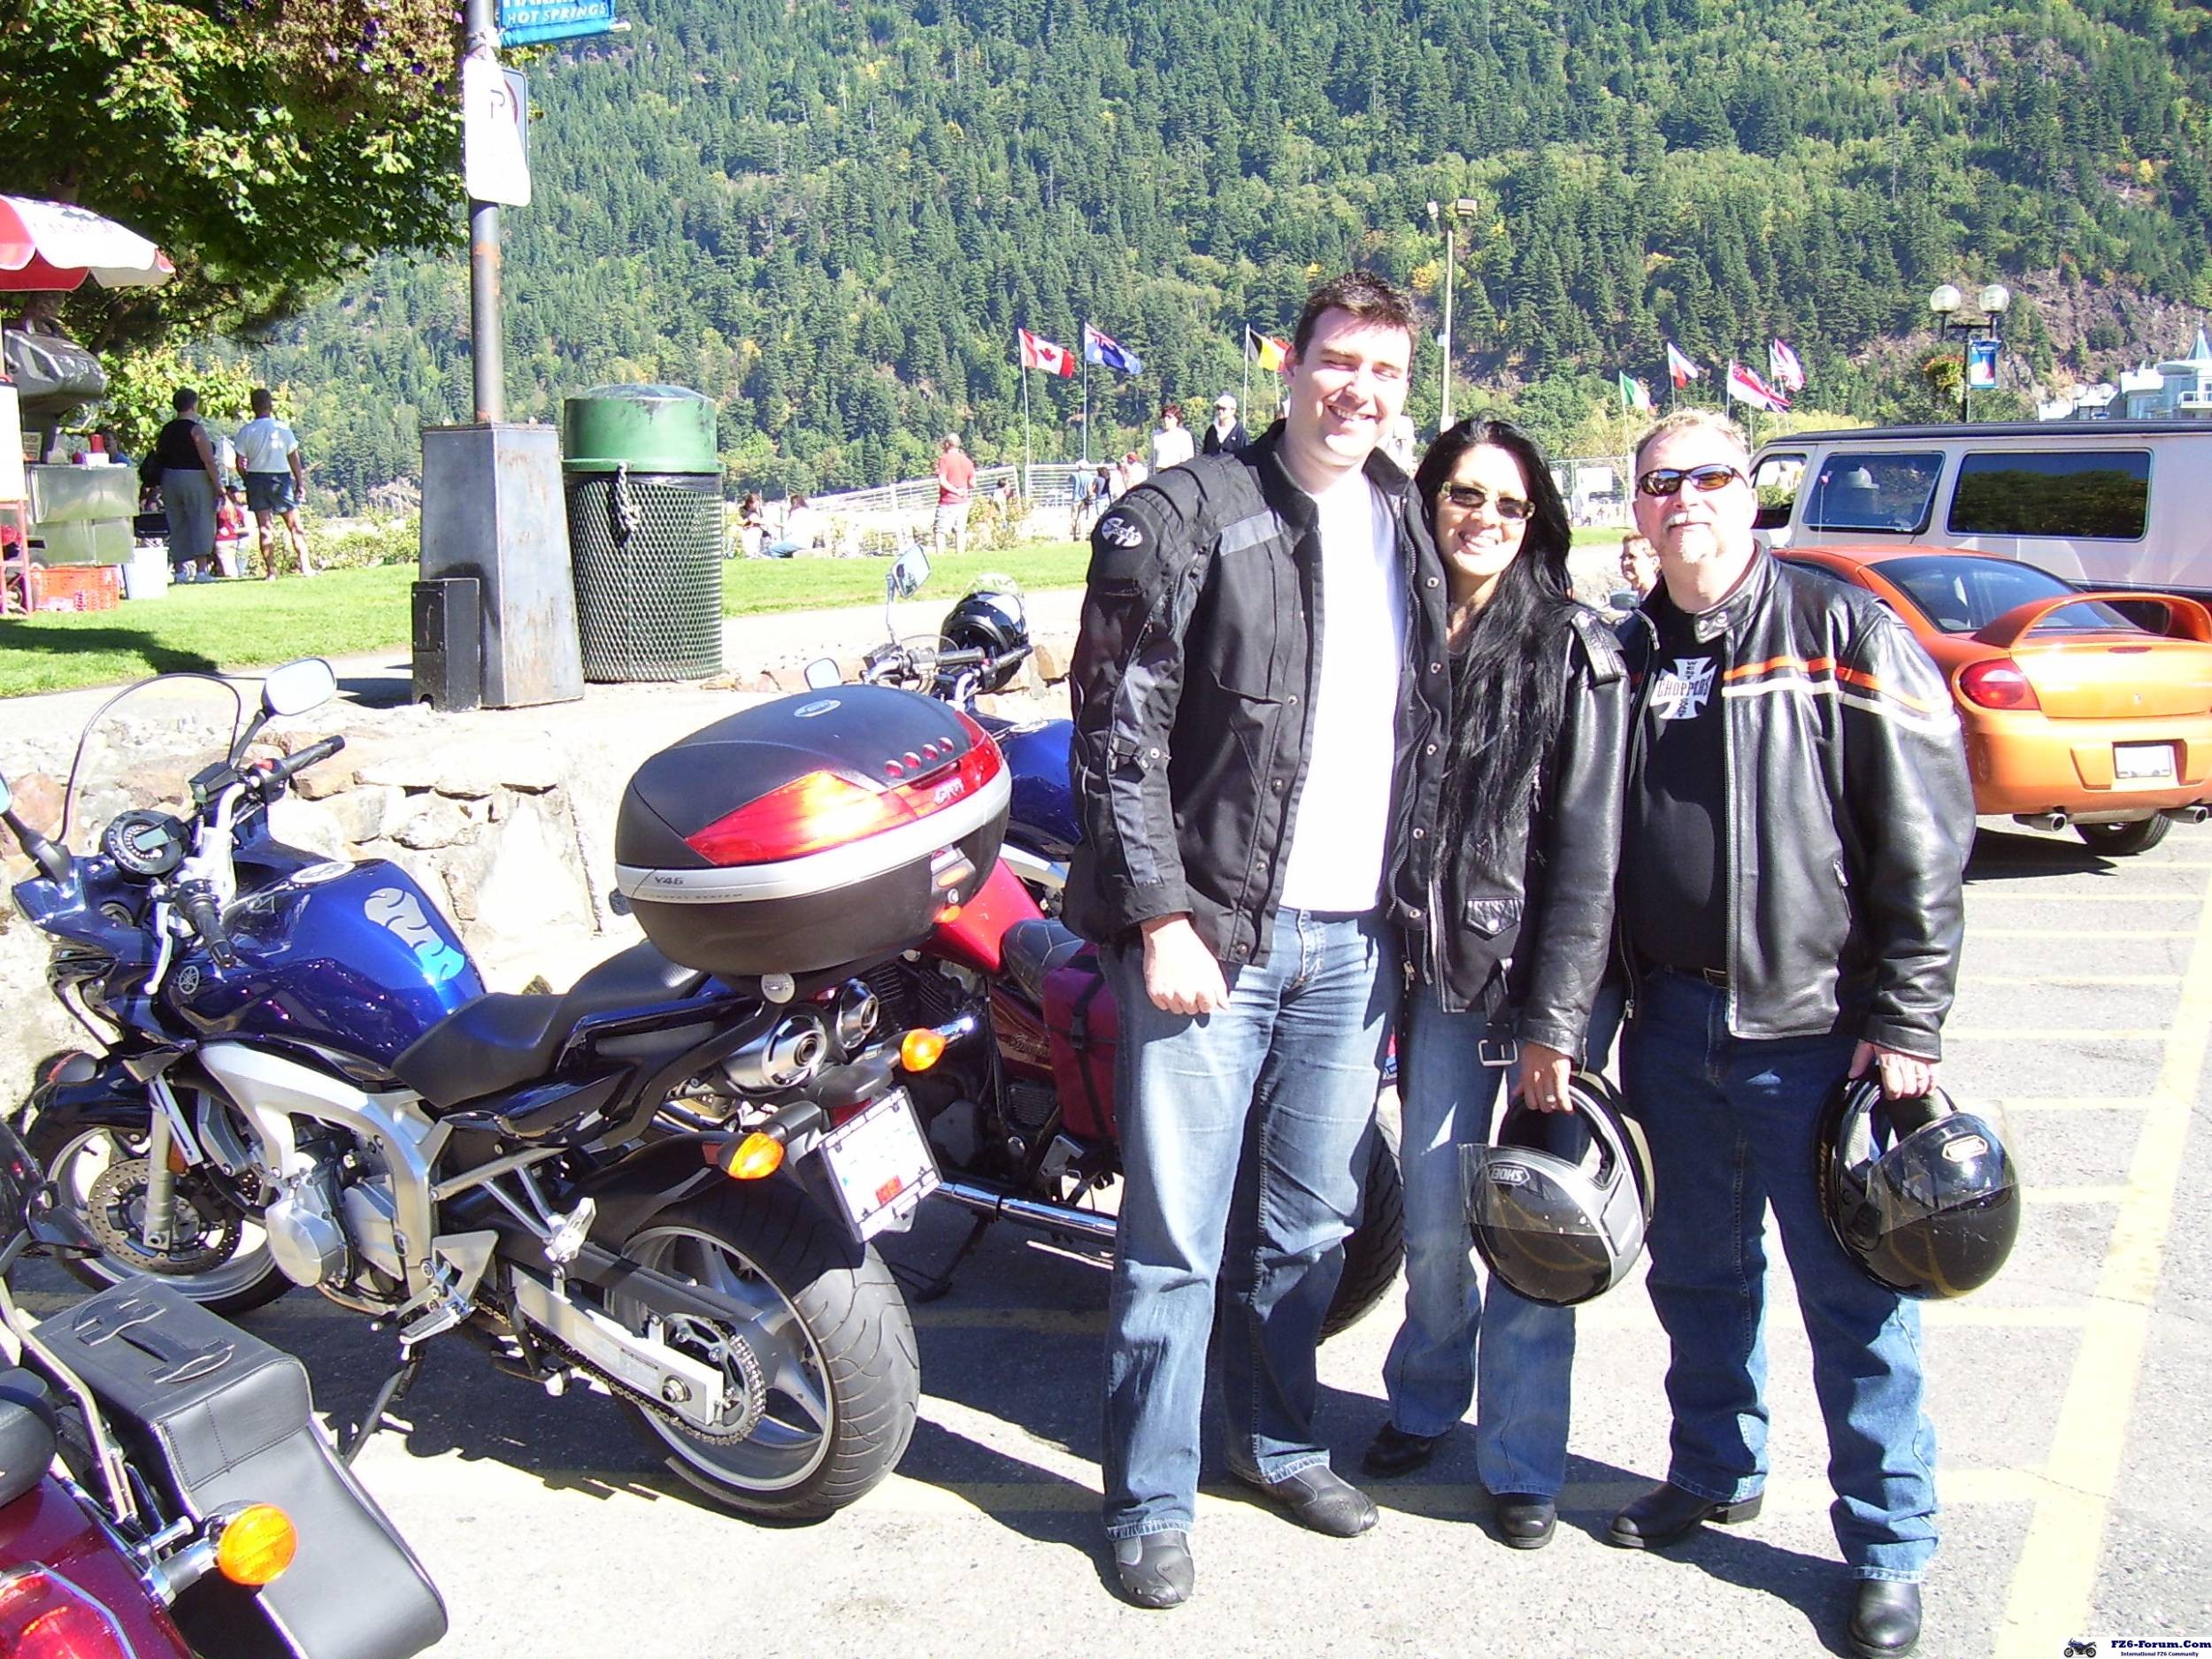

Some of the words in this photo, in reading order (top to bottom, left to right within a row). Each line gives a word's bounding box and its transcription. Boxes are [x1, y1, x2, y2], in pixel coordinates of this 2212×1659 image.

[507, 11, 540, 24] HOT
[543, 4, 607, 21] SPRINGS
[1657, 674, 1712, 697] CHOPPERS
[655, 877, 684, 886] V46
